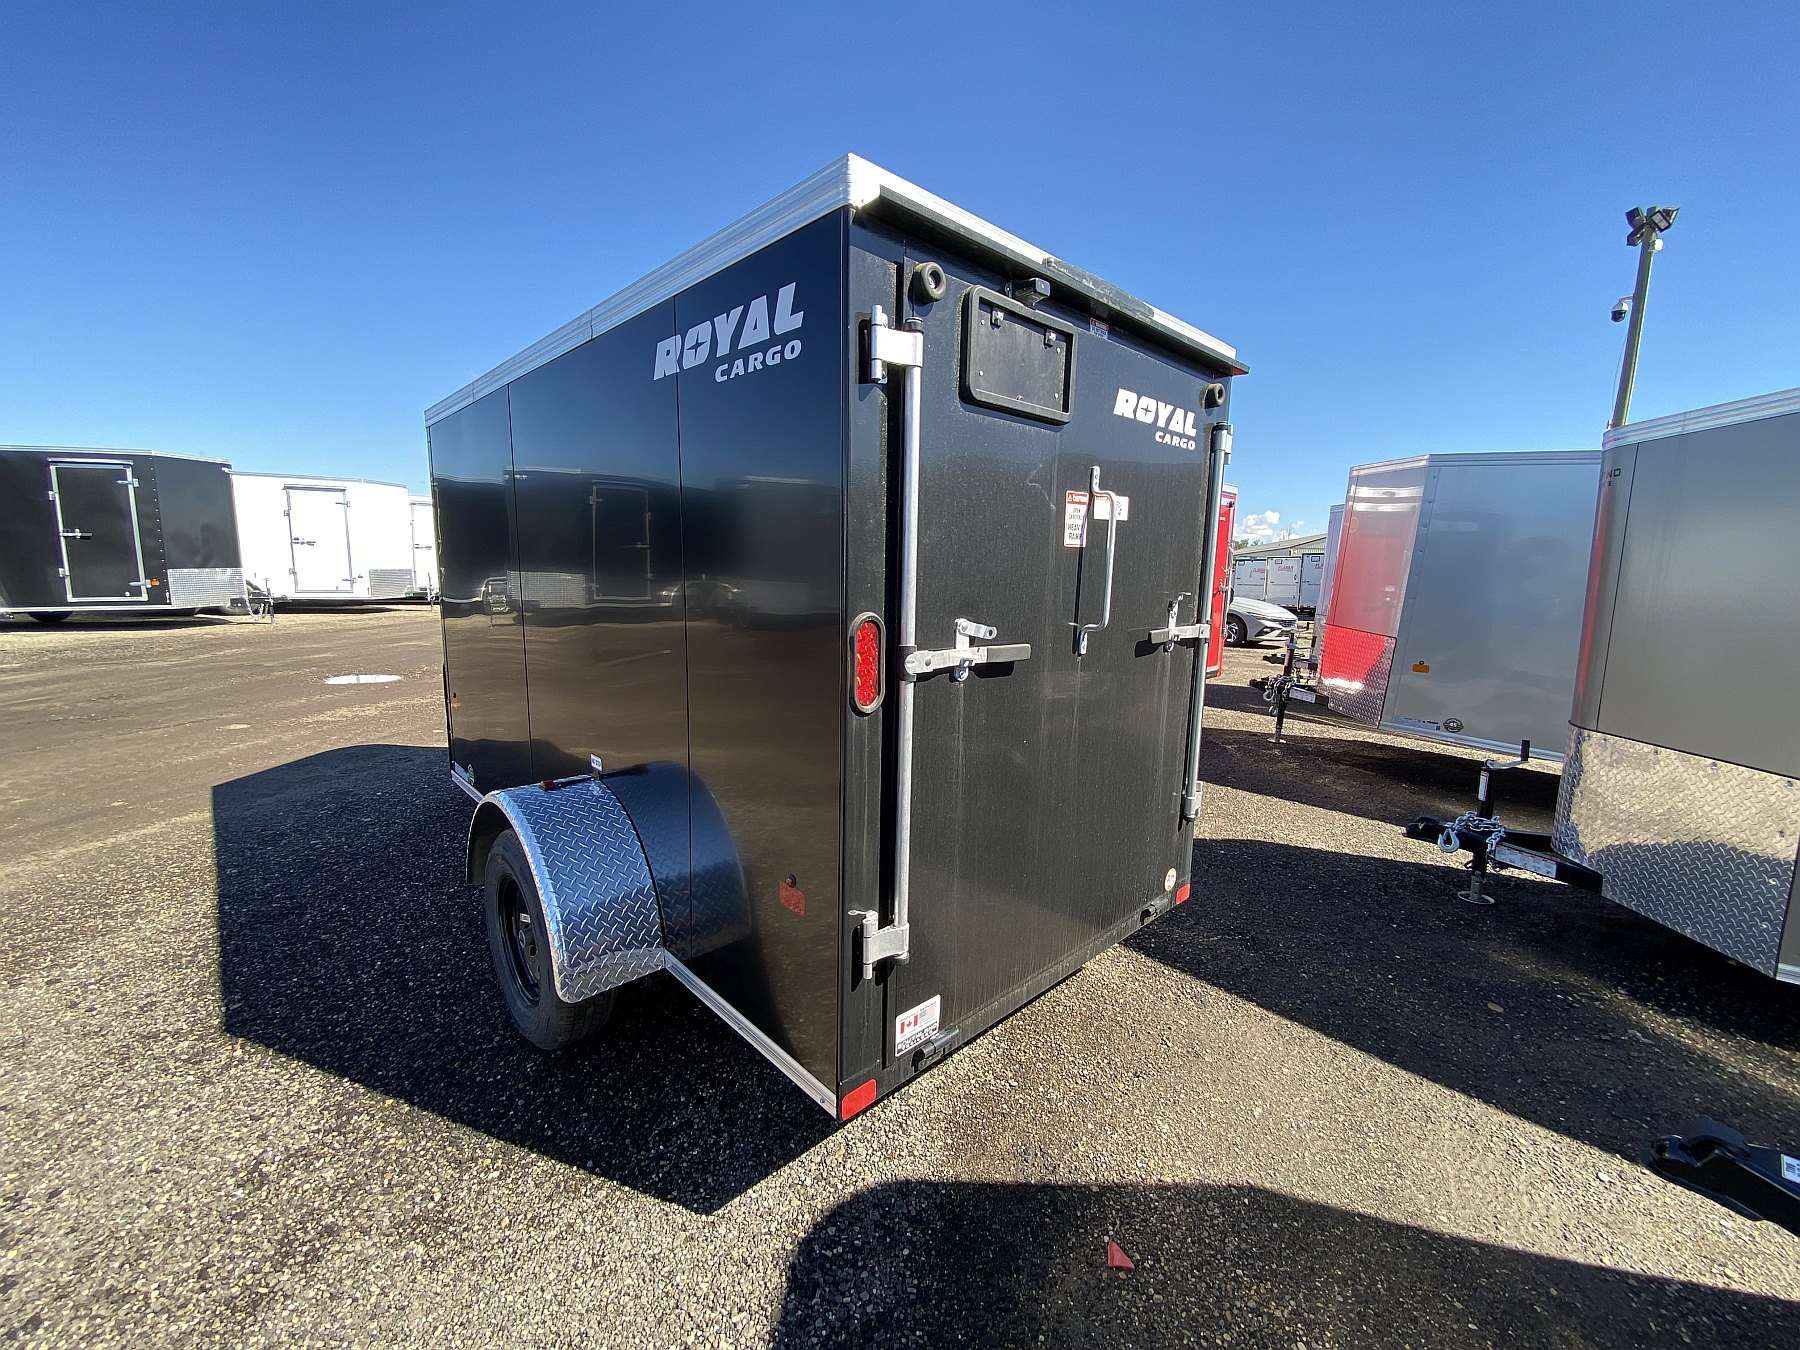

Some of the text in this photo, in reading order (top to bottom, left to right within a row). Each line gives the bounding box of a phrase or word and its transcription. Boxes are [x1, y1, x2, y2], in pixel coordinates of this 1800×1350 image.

[653, 282, 804, 381] ROYAL
[714, 339, 802, 383] CARGO
[1113, 388, 1197, 437] ROYAL
[1155, 431, 1196, 451] CARGO
